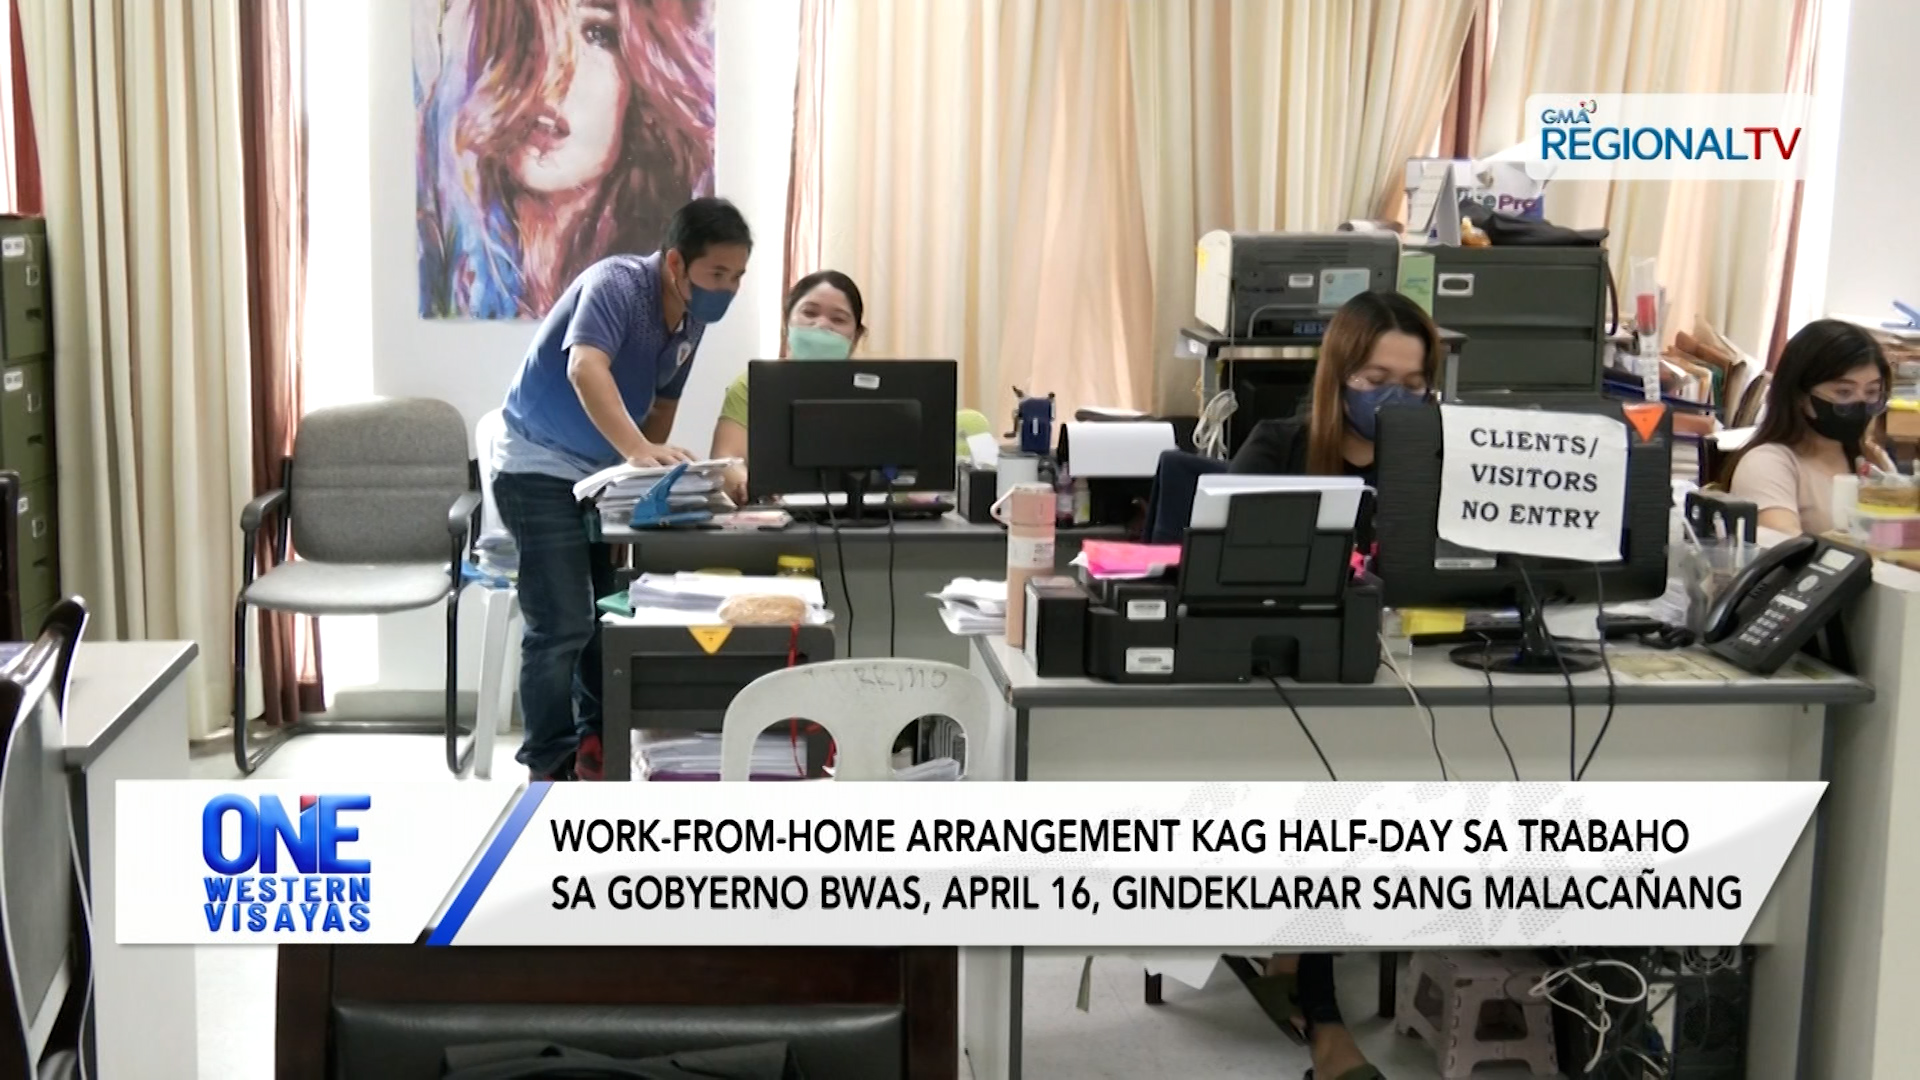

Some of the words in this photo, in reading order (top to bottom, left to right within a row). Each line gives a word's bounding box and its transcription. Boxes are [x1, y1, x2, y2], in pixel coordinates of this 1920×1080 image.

[1470, 427, 1599, 459] CLIENTS/
[1471, 463, 1598, 494] VISITORS
[1461, 500, 1499, 522] NO
[1509, 503, 1600, 530] ENTRY
